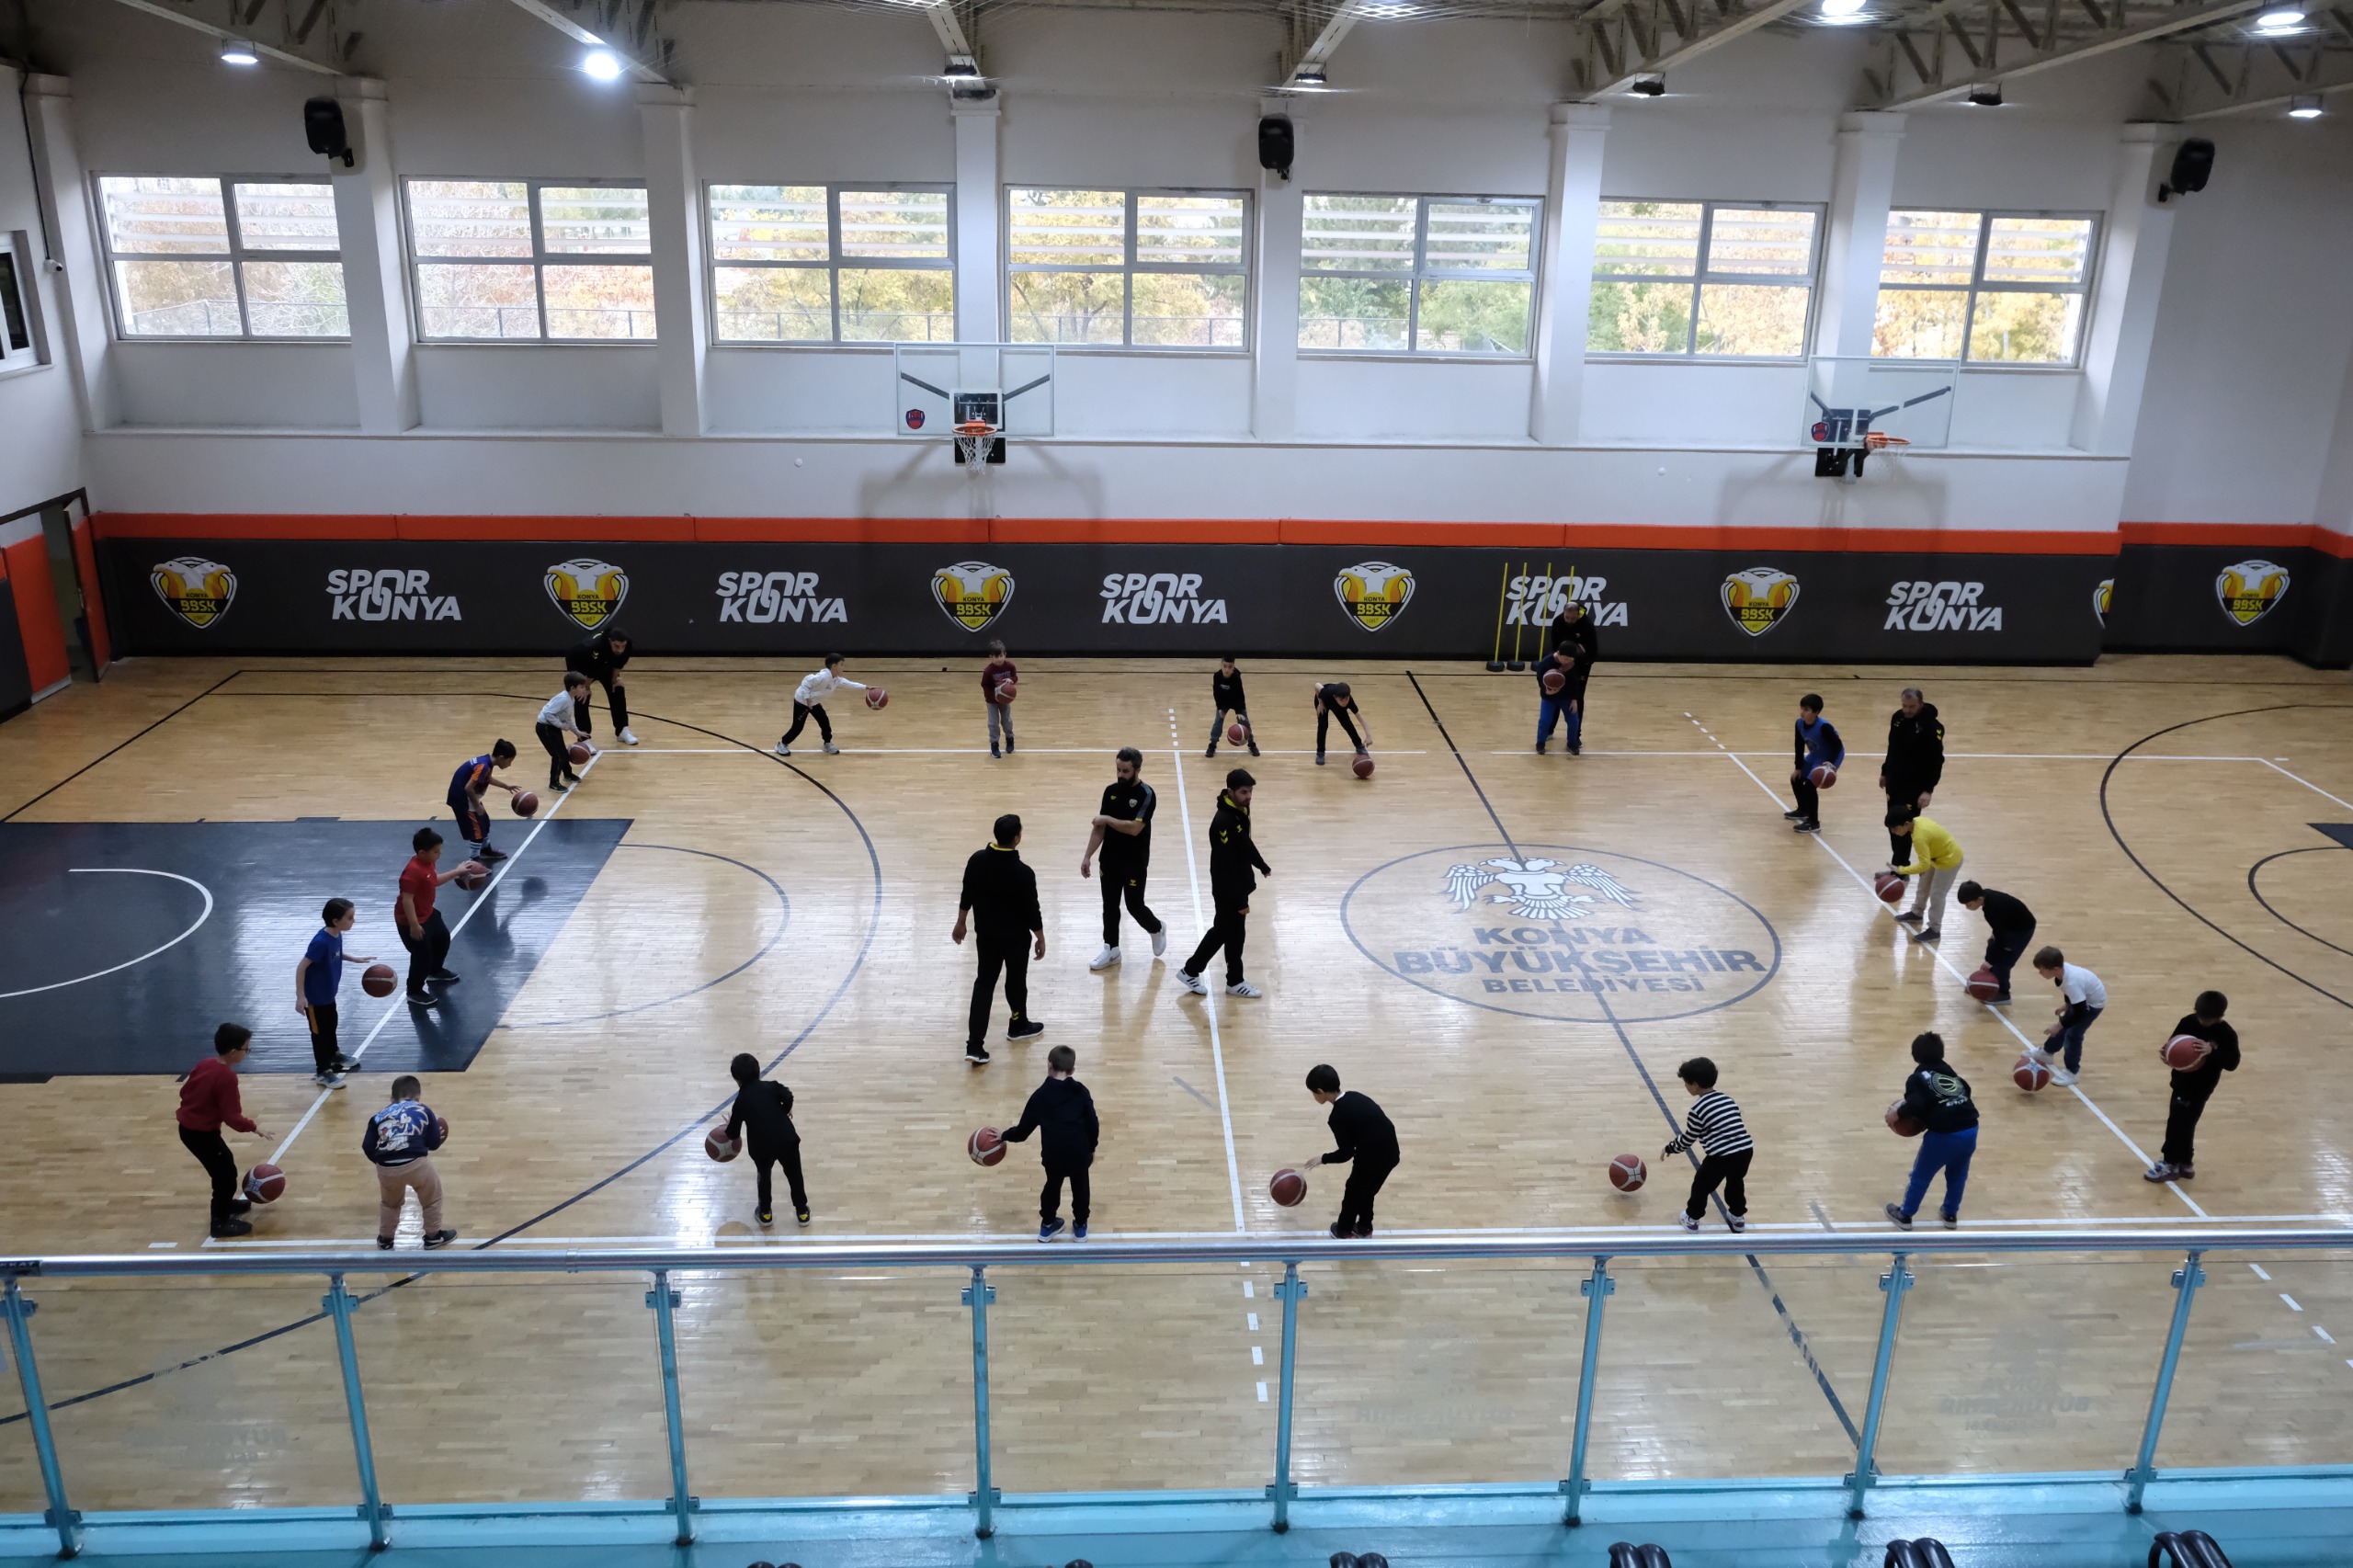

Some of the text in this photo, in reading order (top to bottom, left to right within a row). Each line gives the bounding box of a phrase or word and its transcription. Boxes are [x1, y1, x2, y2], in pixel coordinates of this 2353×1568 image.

[326, 569, 430, 602] SPOR
[715, 572, 819, 604] SPOR
[1099, 574, 1202, 605] SPOR
[1505, 575, 1608, 607] SPOR
[1886, 581, 1984, 612] SPOR
[180, 600, 218, 612] BBSK
[332, 591, 461, 621] KONYA
[571, 601, 607, 613] BBSK
[720, 593, 847, 623] KONYA
[956, 604, 992, 616] BBSK
[1101, 595, 1228, 624] KONYA
[1357, 603, 1392, 615] BBSK
[1506, 597, 1629, 627] KOYA
[1741, 608, 1775, 619] BBSK
[1883, 603, 2002, 631] KONYA
[2233, 599, 2265, 610] BBSK
[1472, 926, 1655, 947] KONYA
[1392, 946, 1768, 977] BÜYÜKŞEHİR
[1484, 976, 1706, 994] BELEDİYESİ
